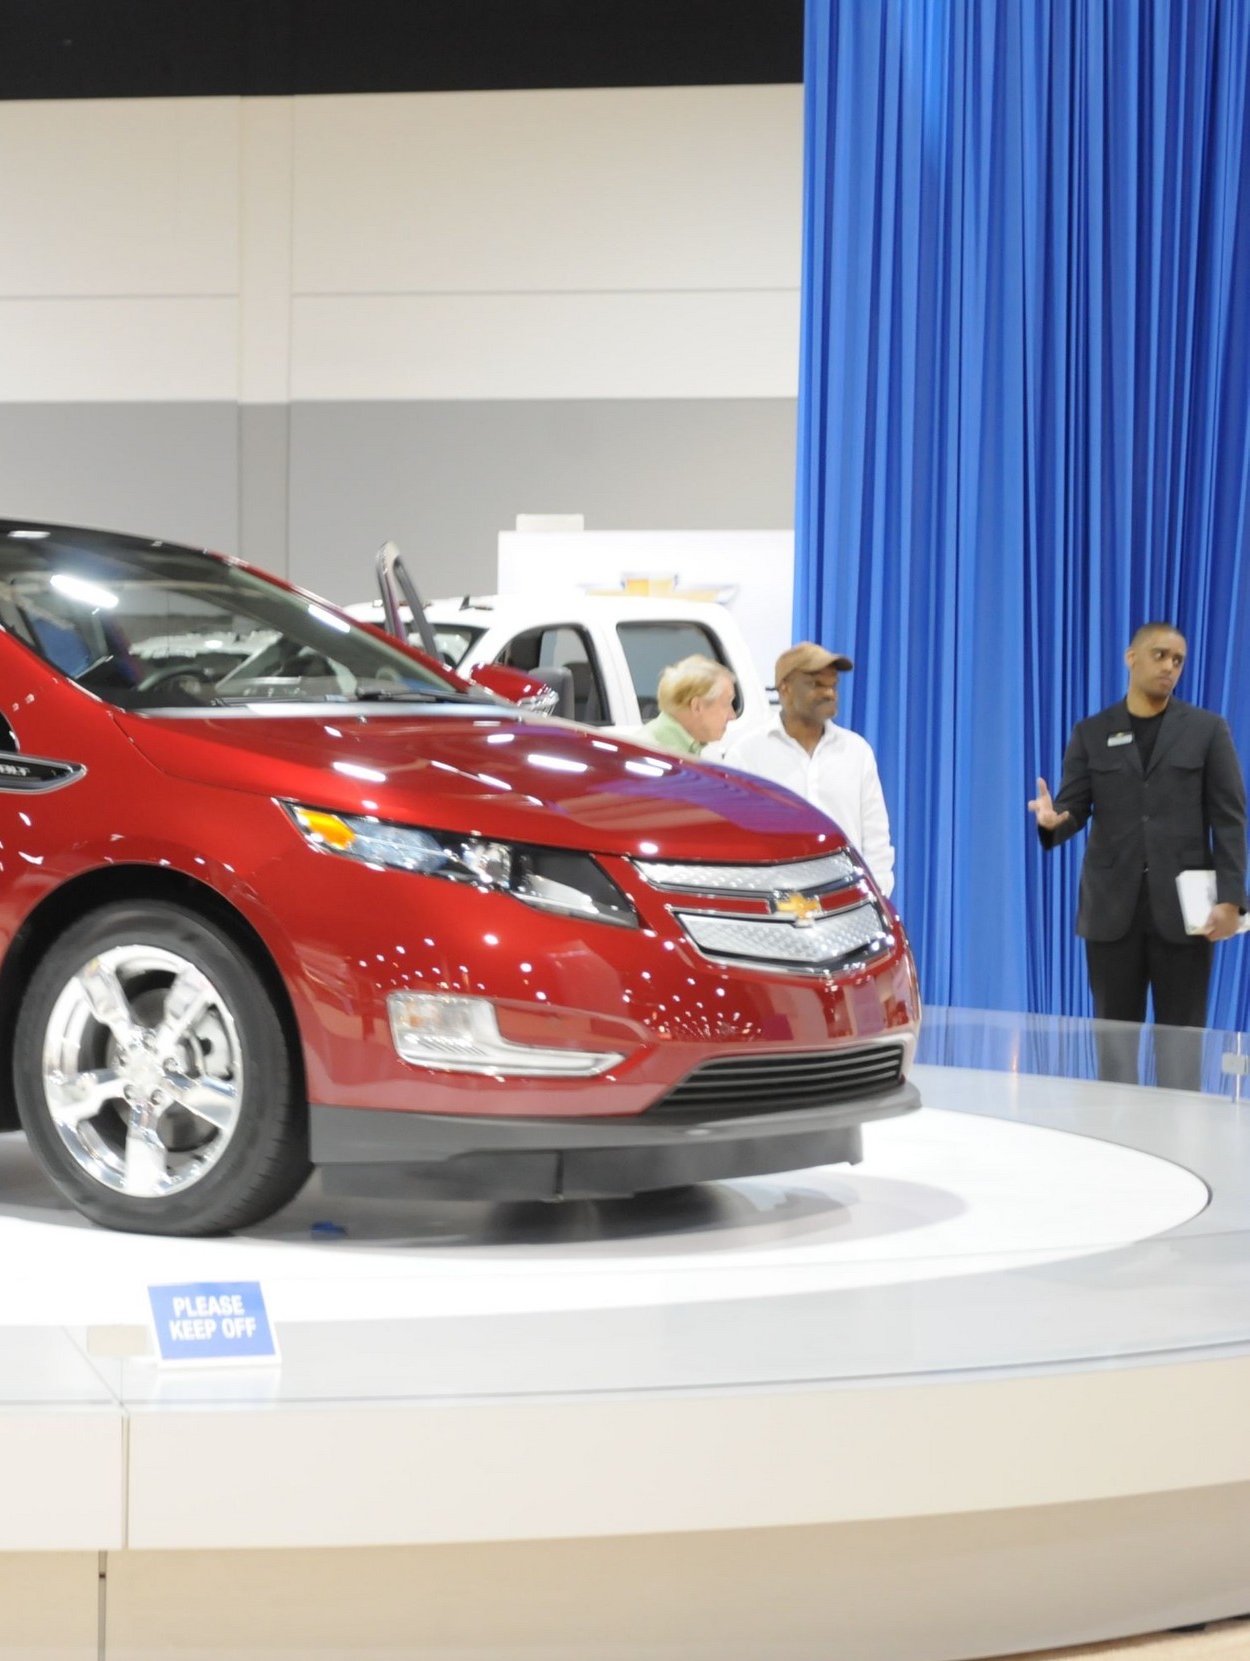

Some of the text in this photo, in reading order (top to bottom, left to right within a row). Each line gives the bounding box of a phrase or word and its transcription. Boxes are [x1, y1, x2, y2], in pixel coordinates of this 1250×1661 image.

[172, 1295, 245, 1317] PLEASE
[169, 1317, 256, 1341] KEEP OFF
